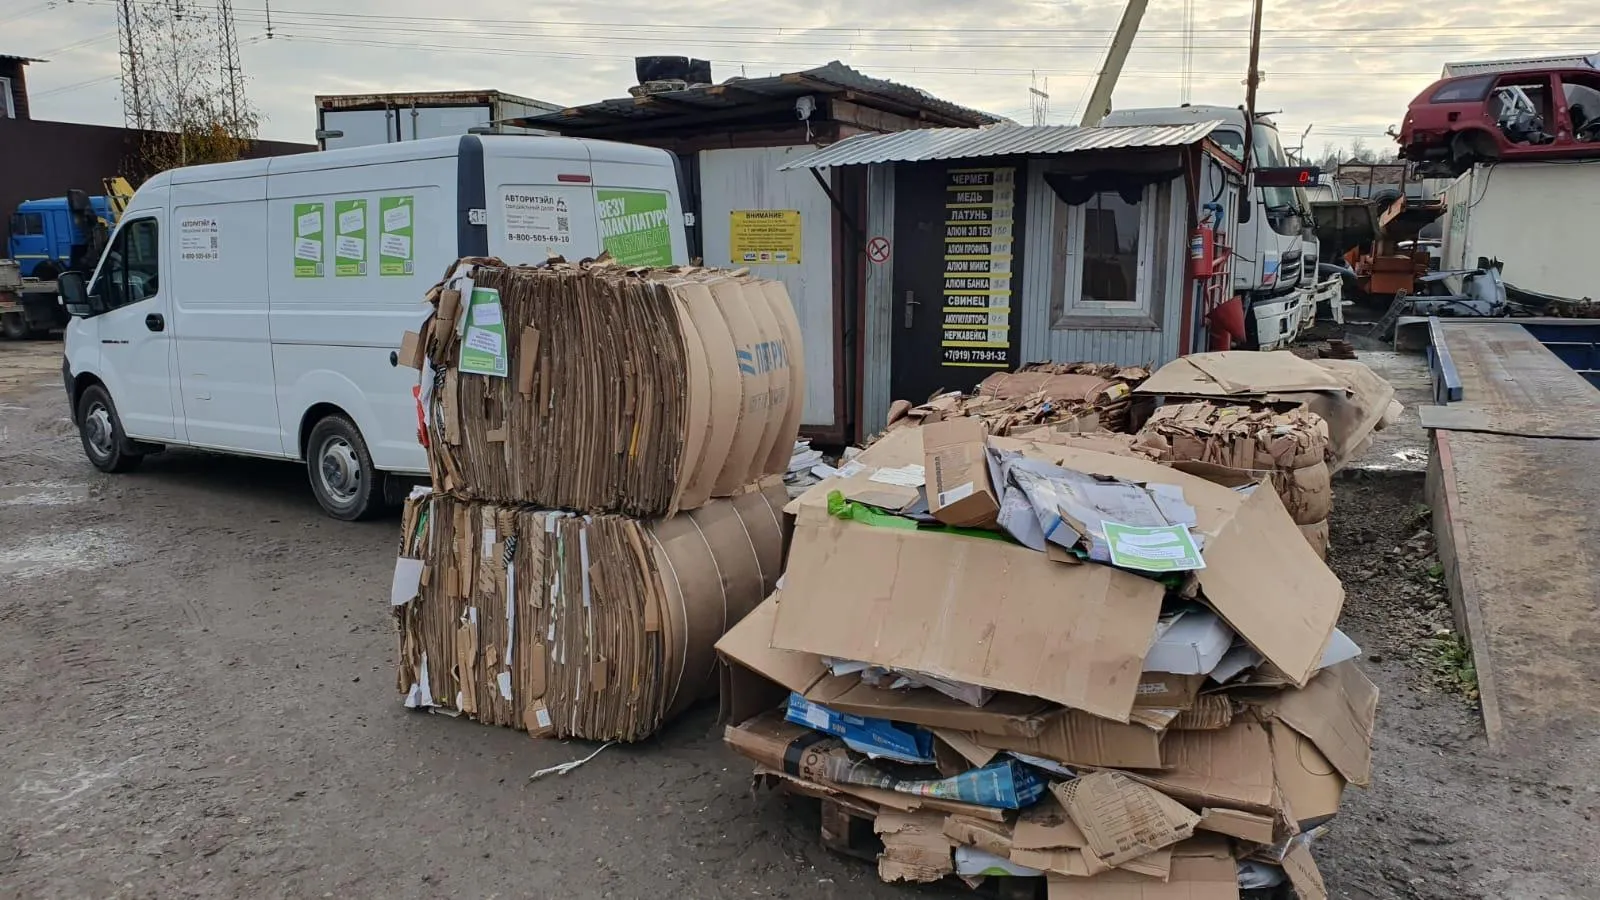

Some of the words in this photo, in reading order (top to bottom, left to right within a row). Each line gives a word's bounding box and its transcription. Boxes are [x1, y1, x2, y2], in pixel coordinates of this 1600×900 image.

[952, 174, 989, 184] ЧЕРМЕТ
[1299, 171, 1309, 182] 0
[505, 194, 554, 204] АВТОРИТЭЙЛ
[957, 192, 983, 203] МЕДЬ
[597, 197, 625, 219] ВЕЗУ
[952, 210, 988, 220] ЛАТУНЬ
[968, 226, 977, 236] ЭЛ
[978, 226, 992, 236] ТЕХ
[508, 233, 570, 243] 8-800-505-69-10
[947, 261, 968, 271] АЛЮМ
[970, 261, 989, 271] МИКС
[945, 279, 966, 289] АЛЮМ
[967, 279, 989, 289] БАНКА
[948, 296, 985, 307] СВИНЕЦ
[945, 314, 988, 324] АККУМУЛЯТОРЫ
[944, 329, 986, 340] НЕРЖАВЕЙКА
[944, 350, 970, 361] +7(919)
[972, 350, 1006, 361] 779-91-32
